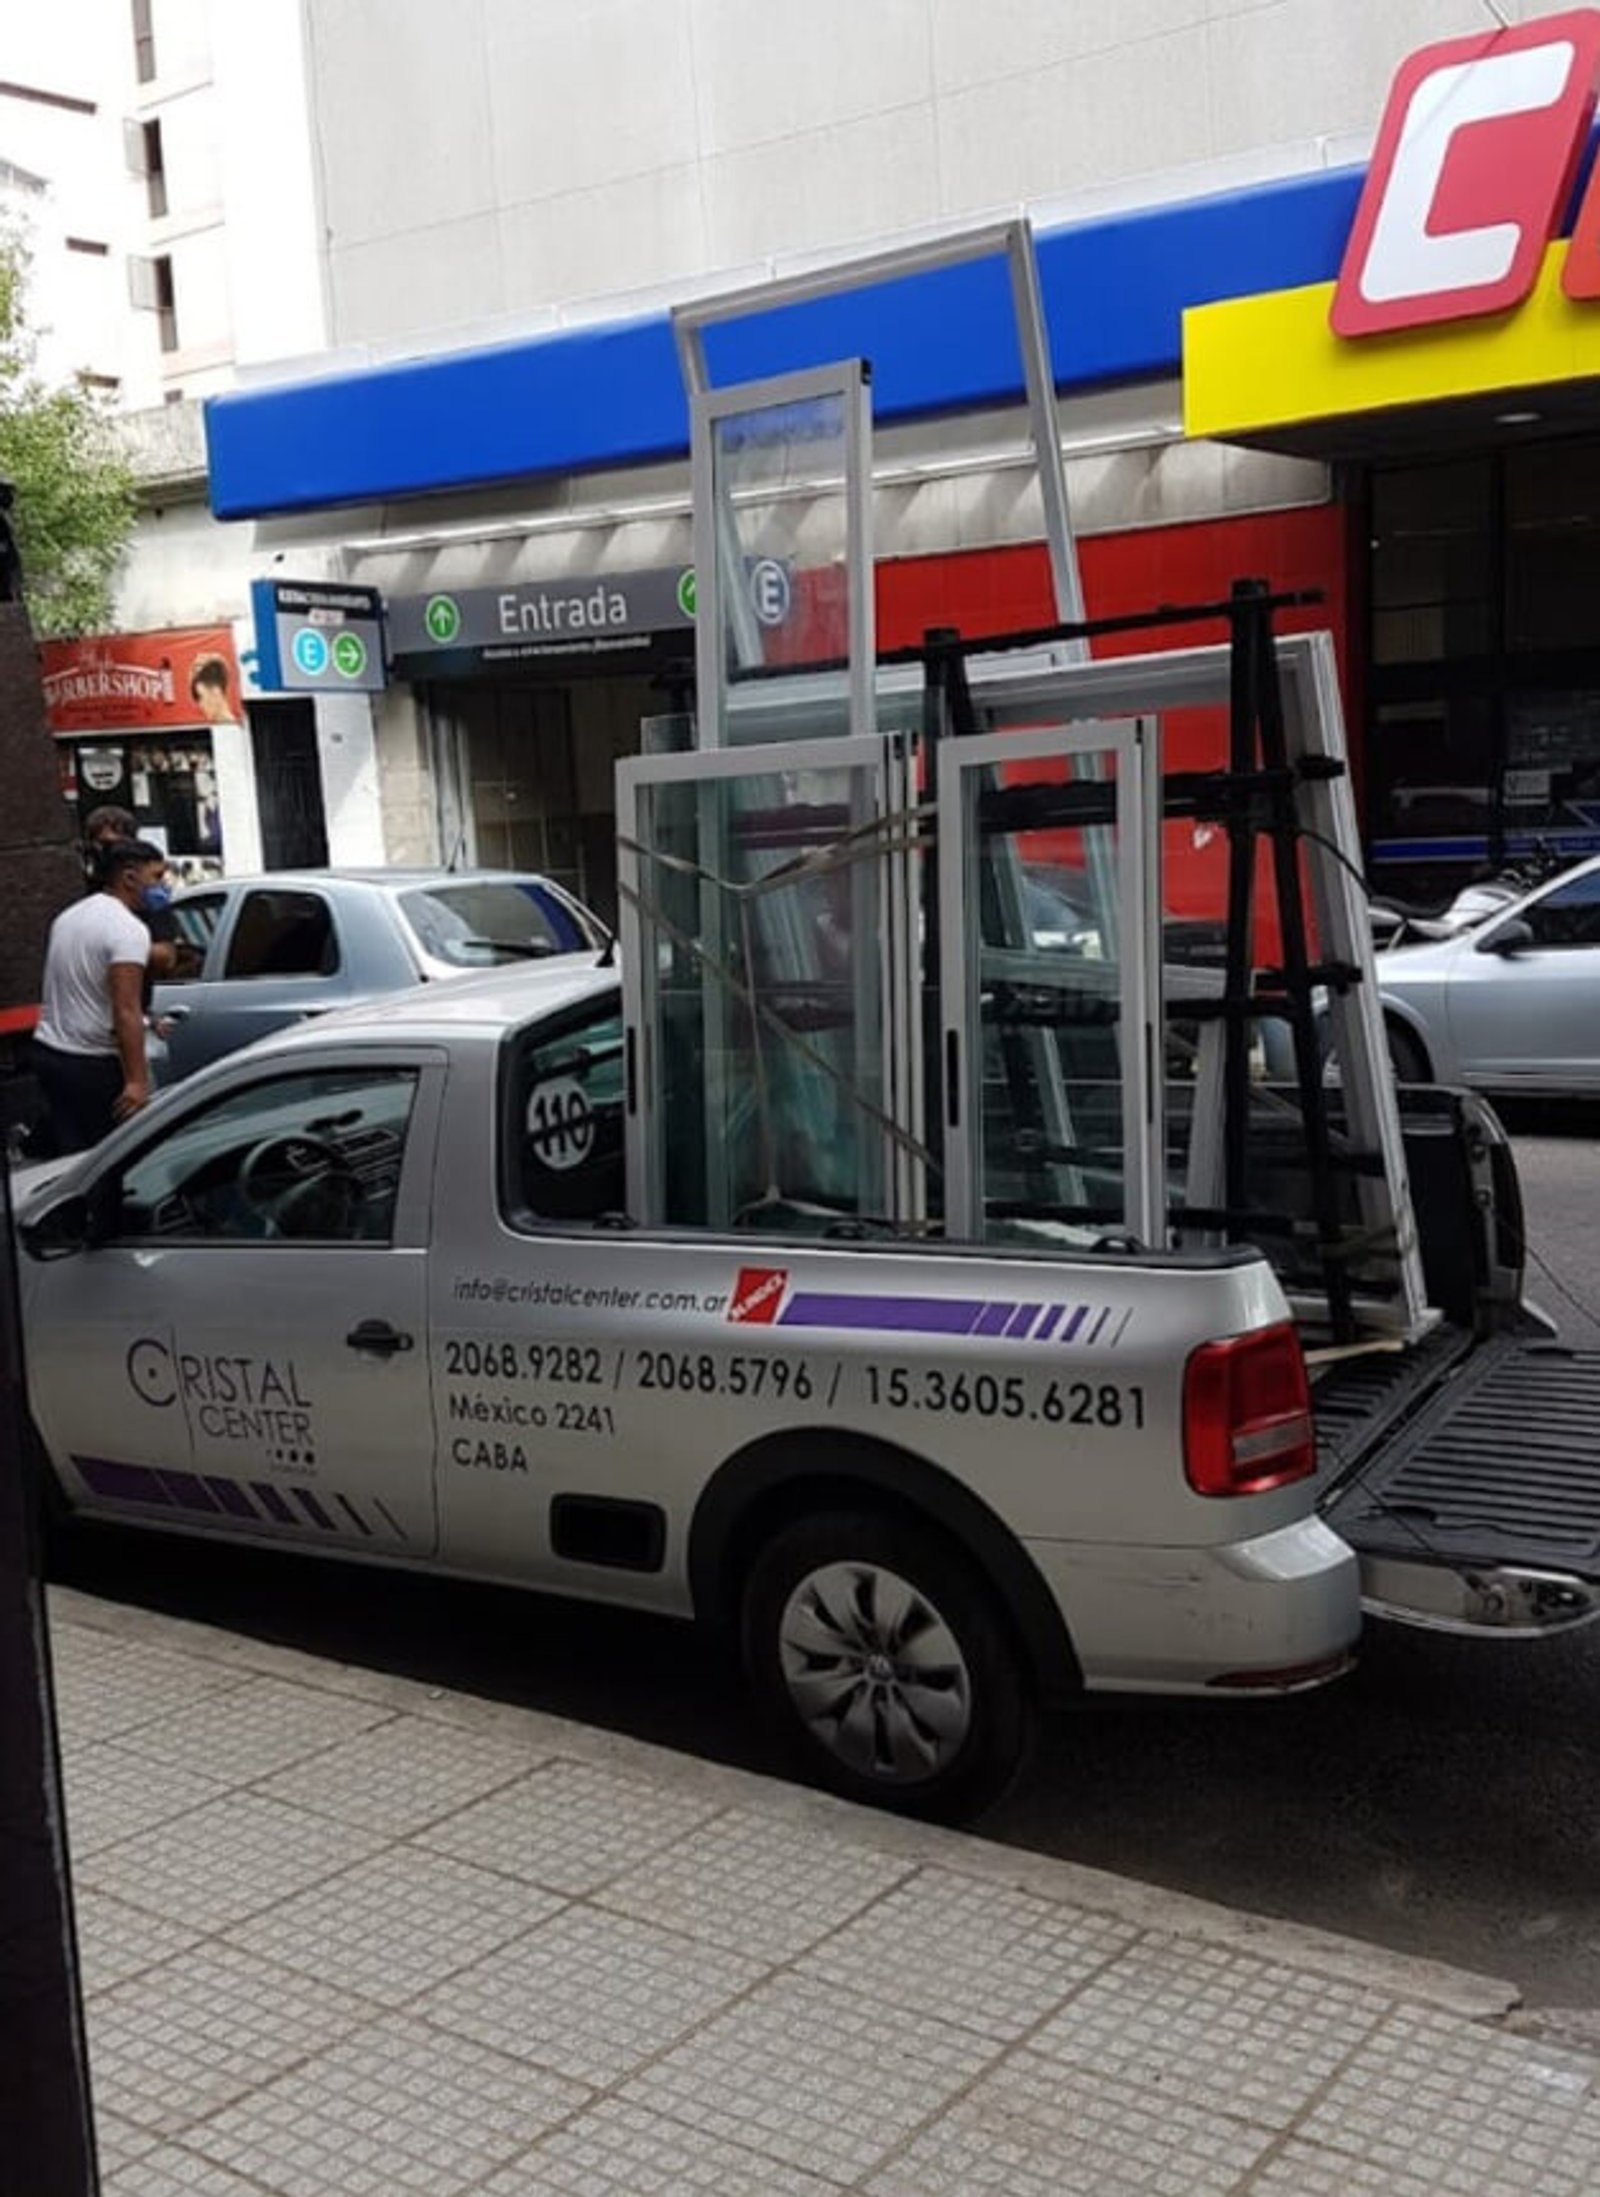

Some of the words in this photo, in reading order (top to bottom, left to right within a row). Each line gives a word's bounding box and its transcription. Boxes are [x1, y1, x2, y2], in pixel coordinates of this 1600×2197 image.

[1360, 40, 1576, 303] C
[498, 585, 627, 633] Entrada
[761, 570, 781, 621] E
[533, 1091, 591, 1158] 110
[454, 1276, 728, 1312] info@cristalcenter.com.ar
[127, 1337, 313, 1408] CRISTAL
[445, 1341, 604, 1385] 2068.9282
[637, 1352, 813, 1401] 2068.5796
[866, 1366, 1146, 1430] 15.3605.6281
[199, 1404, 315, 1446] CENTER
[449, 1394, 548, 1428] México
[555, 1403, 616, 1434] 2241
[452, 1438, 528, 1473] CABA
